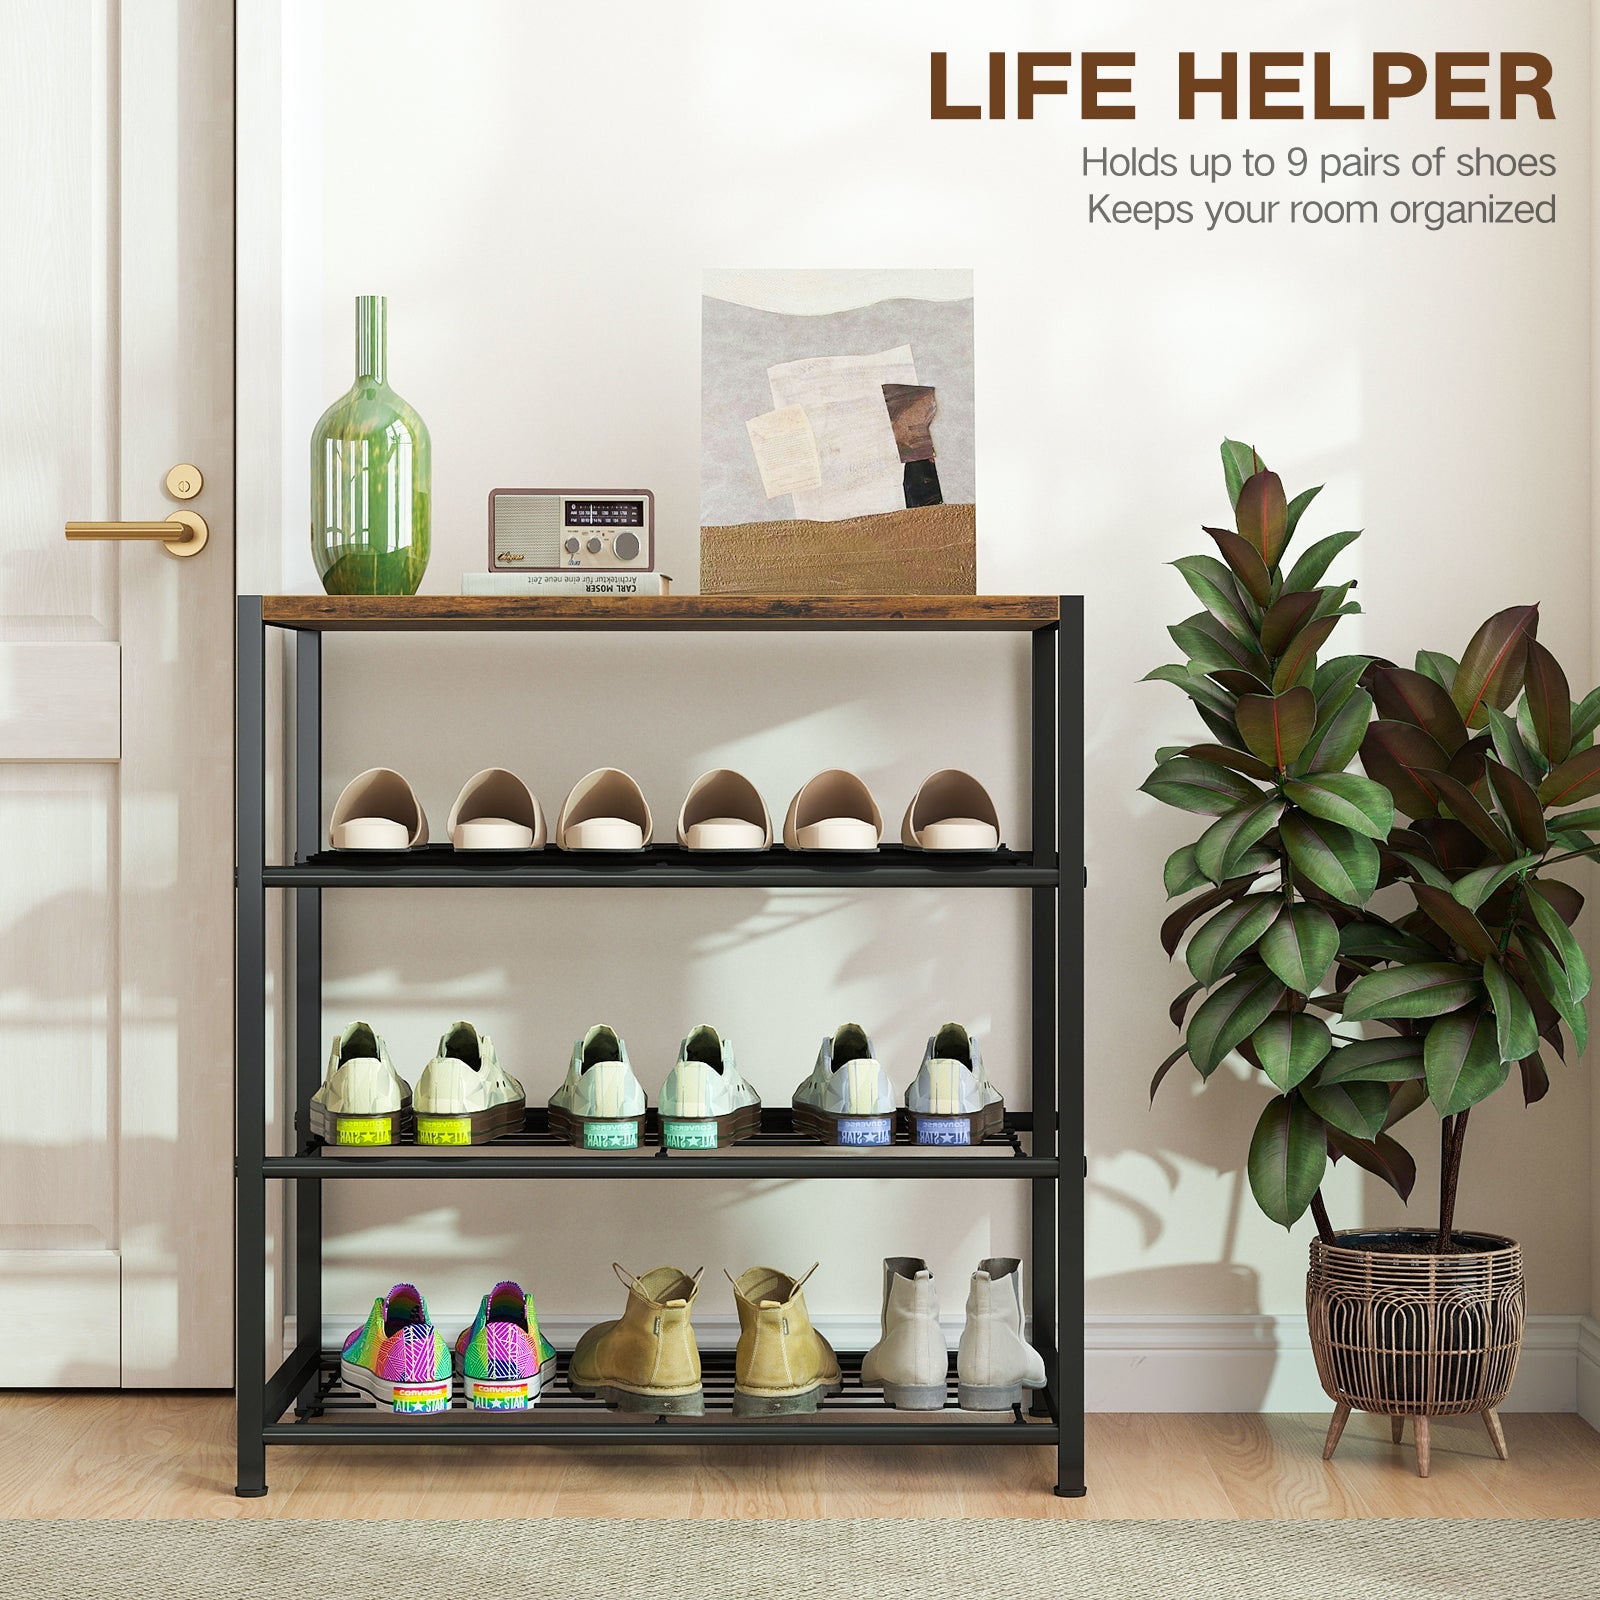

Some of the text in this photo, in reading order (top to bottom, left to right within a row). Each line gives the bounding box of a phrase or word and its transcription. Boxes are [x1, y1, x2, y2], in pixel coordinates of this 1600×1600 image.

[582, 576, 593, 584] für
[595, 576, 637, 584] Architektur
[396, 1399, 444, 1412] ALL STAR
[476, 1396, 524, 1409] ALL STAR
